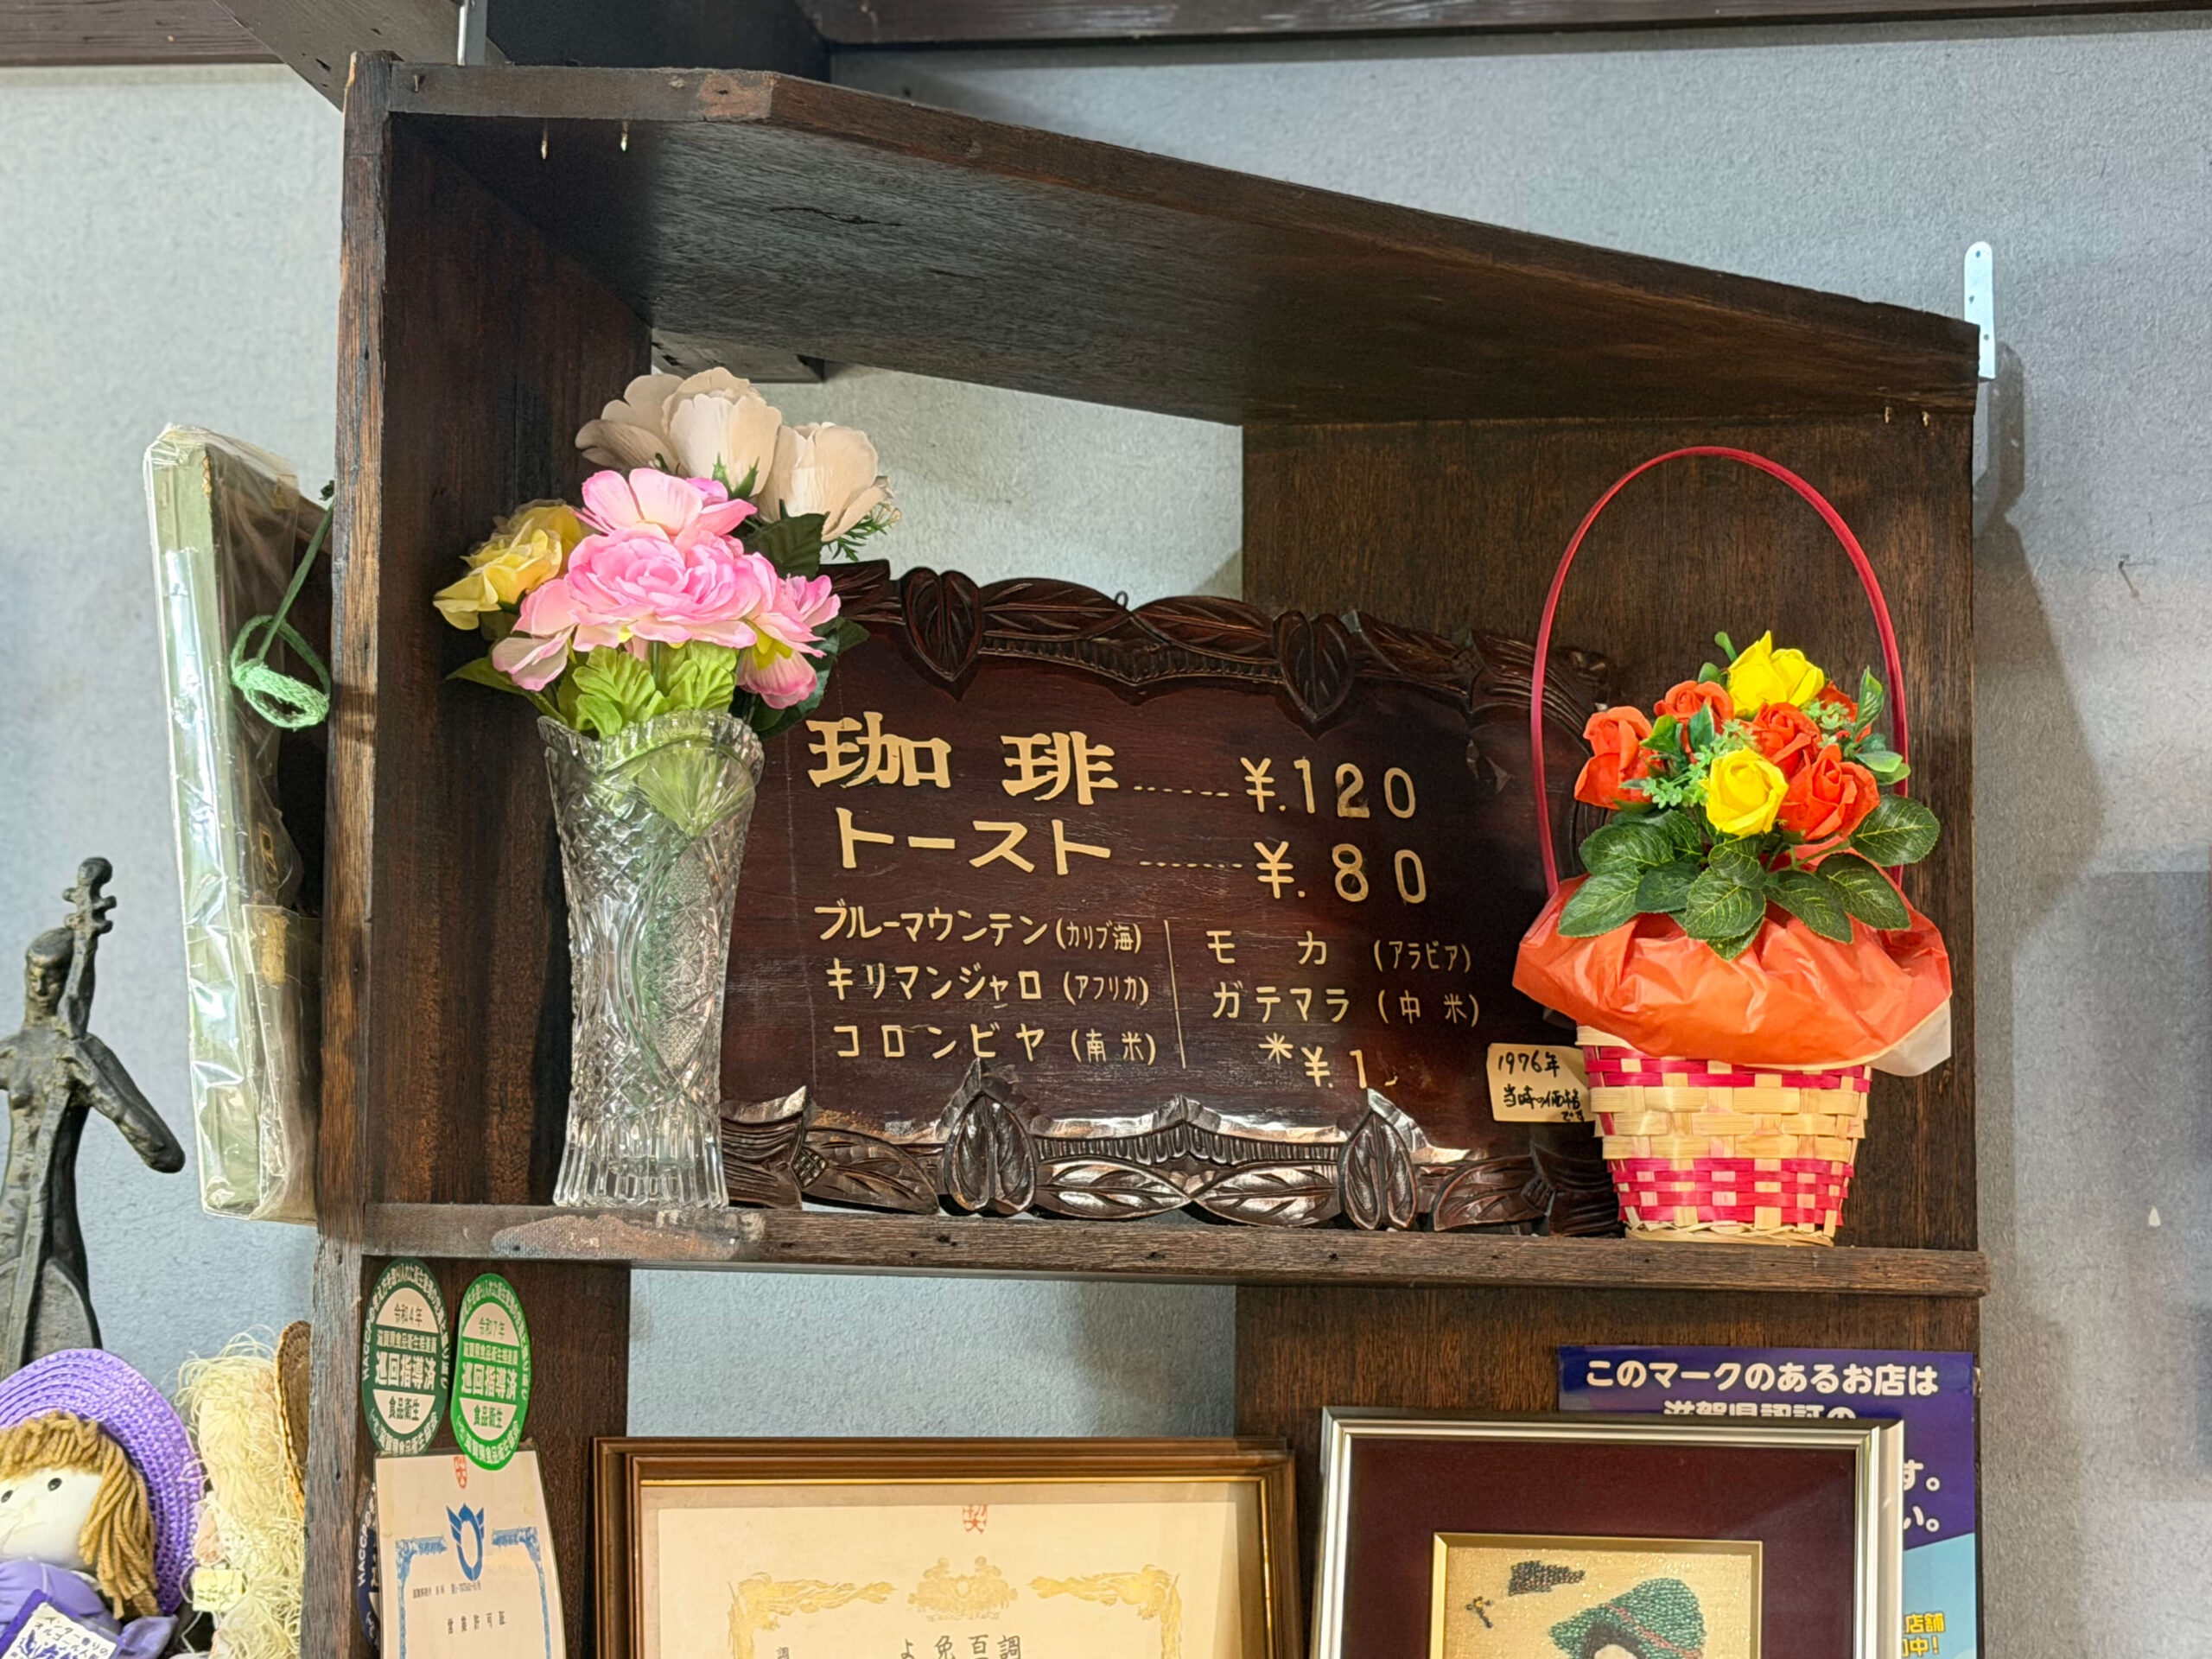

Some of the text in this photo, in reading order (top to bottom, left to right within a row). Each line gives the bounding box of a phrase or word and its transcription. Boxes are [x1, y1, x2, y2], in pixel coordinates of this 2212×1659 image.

[836, 808, 1111, 875] トースト
[1213, 981, 1351, 1024] ガテマラ
[834, 1022, 1046, 1063] コロンビヤ
[1498, 1050, 1560, 1078] 1976年
[1503, 1083, 1582, 1111] 当時の価格
[393, 1302, 424, 1328] 令和4年
[374, 1351, 437, 1391] 巡回指導済
[461, 1363, 519, 1402] 巡回指導済
[1586, 1360, 1939, 1396] このマークのあるお店は
[387, 1395, 421, 1422] 食品衛生
[473, 1404, 504, 1430] 食品衛生
